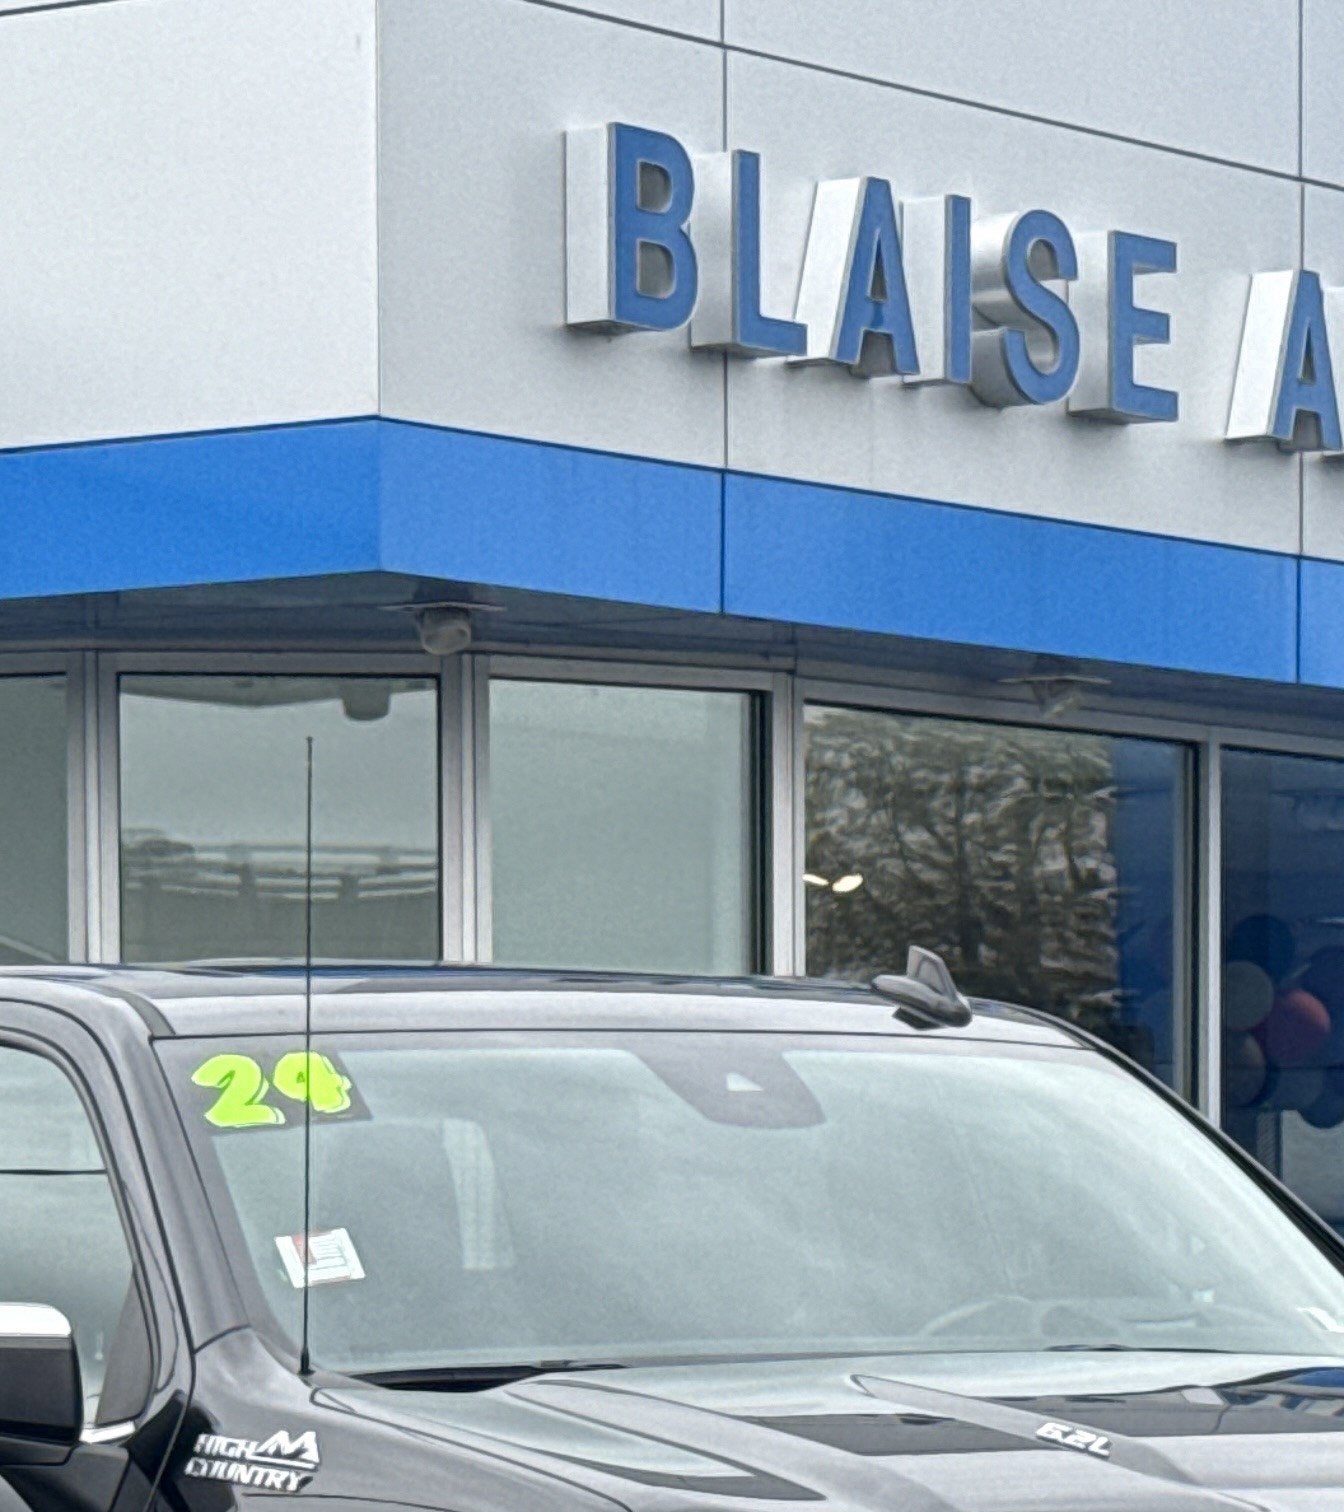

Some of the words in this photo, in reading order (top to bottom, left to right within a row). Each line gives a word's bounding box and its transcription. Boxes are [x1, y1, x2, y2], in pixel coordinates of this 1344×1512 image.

[606, 121, 1179, 424] BLAISE
[191, 1051, 352, 1127] 24
[185, 1456, 310, 1492] COUNTRY
[194, 1433, 260, 1459] HIGH
